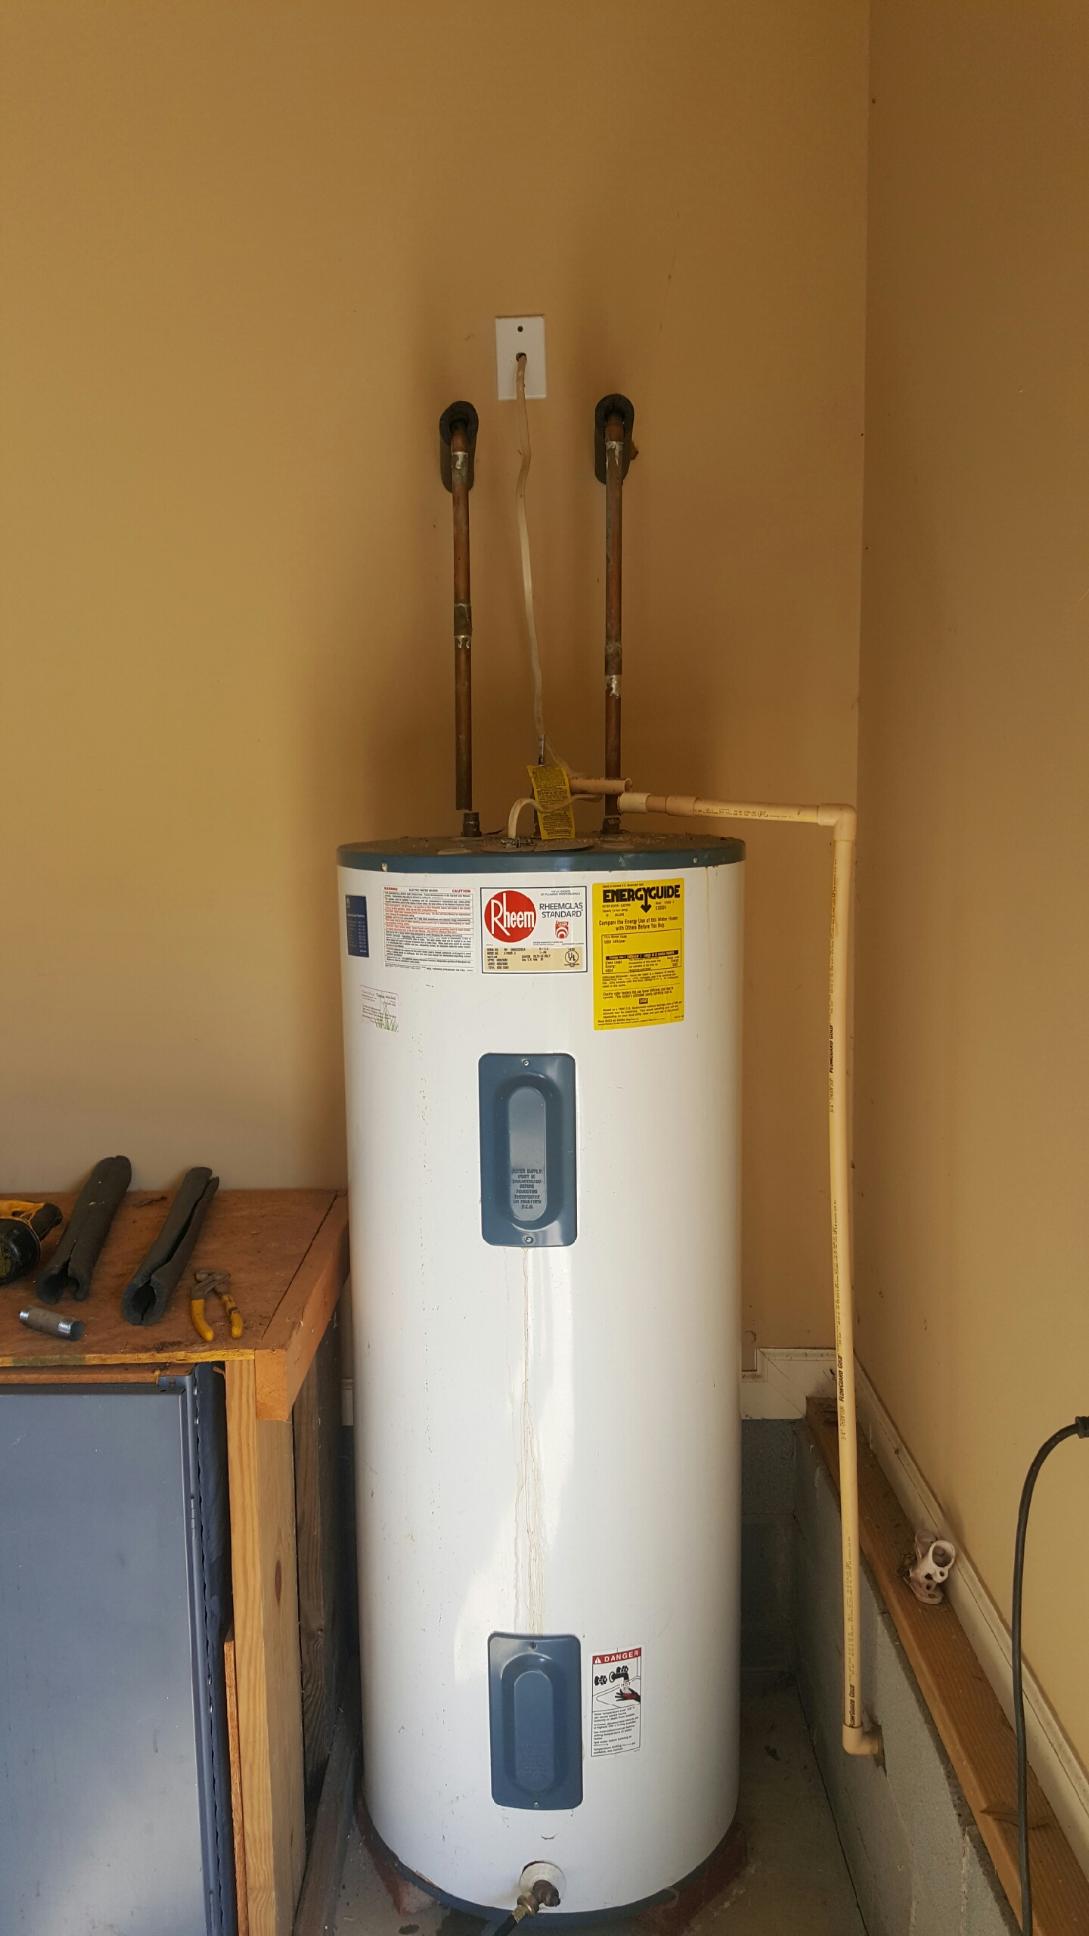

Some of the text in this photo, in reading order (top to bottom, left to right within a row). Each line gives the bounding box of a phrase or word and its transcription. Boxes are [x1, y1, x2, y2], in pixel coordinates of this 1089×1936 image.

[603, 885, 680, 903] ENERGYGUIDE
[491, 892, 534, 936] Rheem
[541, 911, 582, 919] STANDARD
[604, 1653, 638, 1663] DANGER
